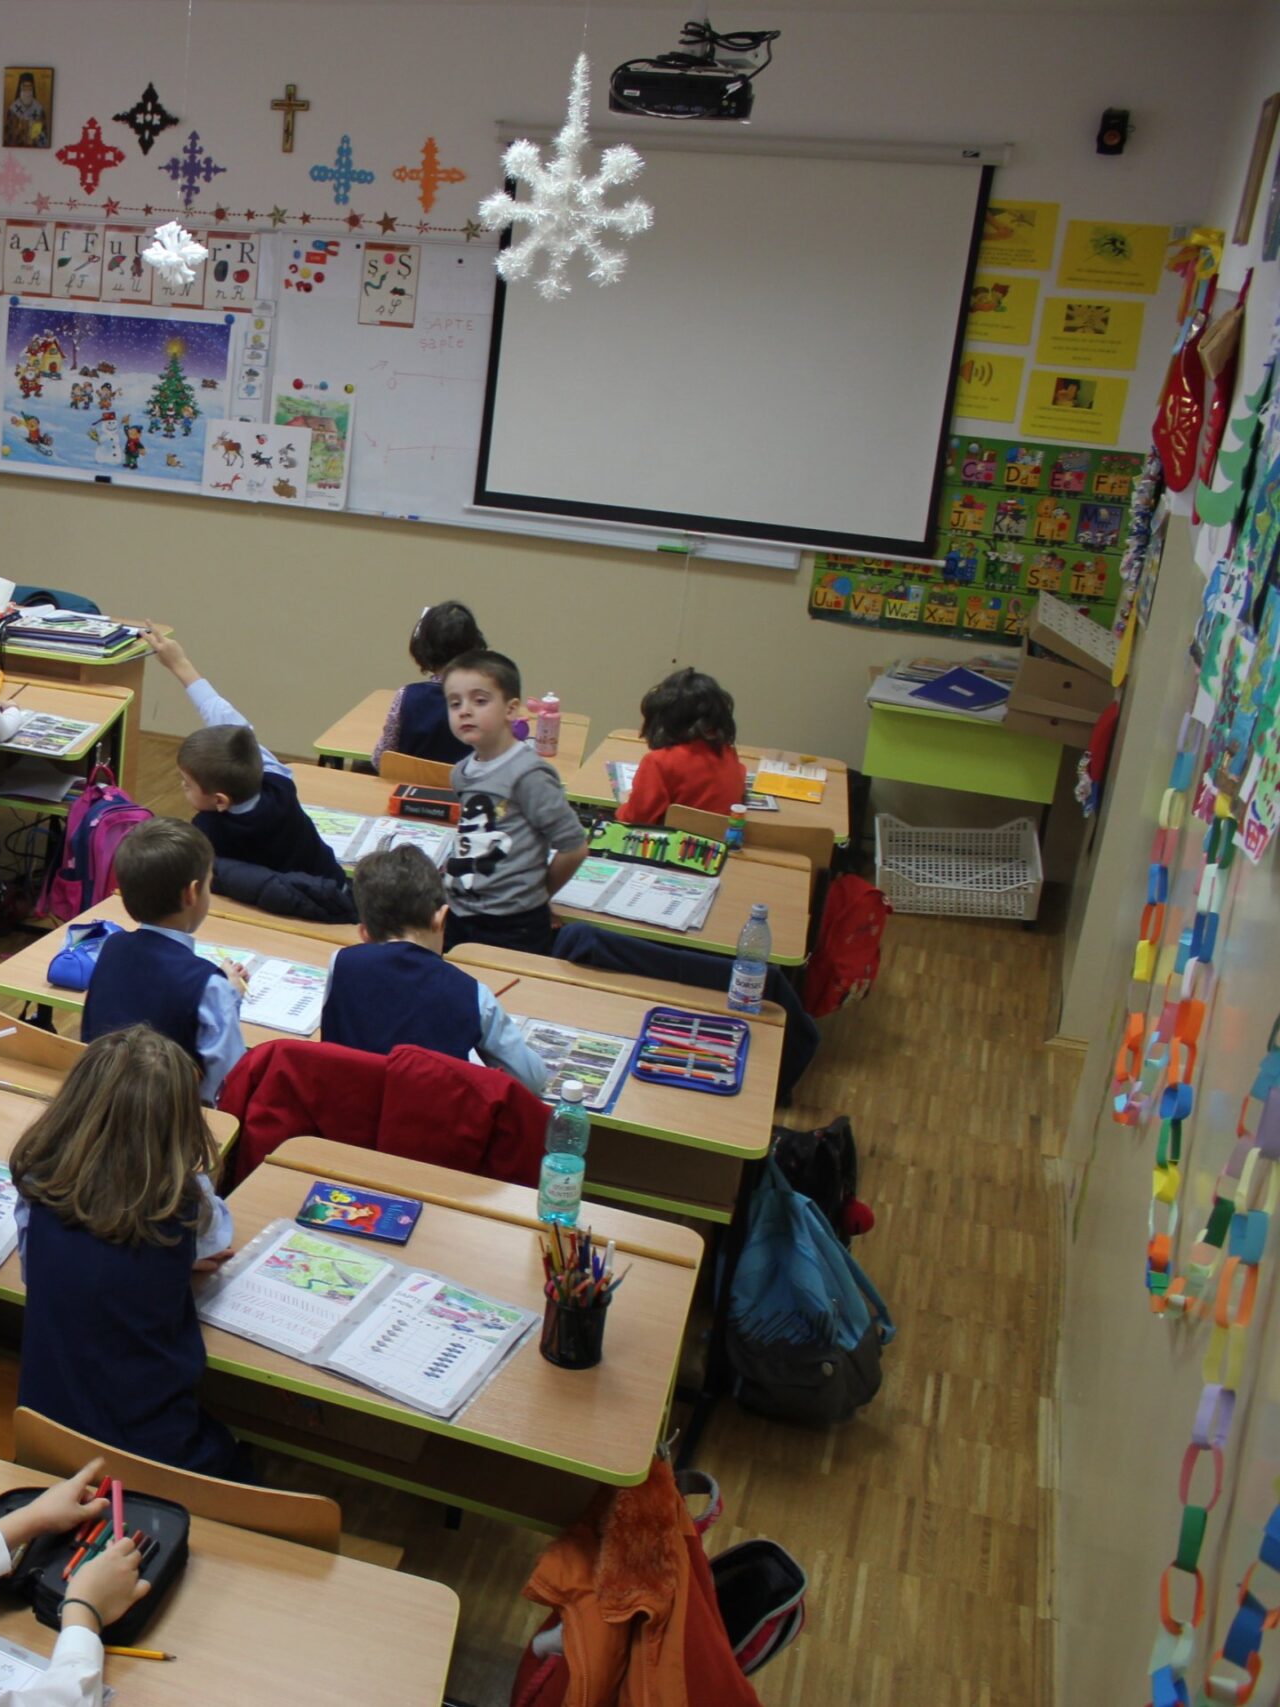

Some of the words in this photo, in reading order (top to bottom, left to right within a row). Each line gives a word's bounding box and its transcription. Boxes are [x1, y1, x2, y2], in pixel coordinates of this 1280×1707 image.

[61, 231, 70, 250] f
[83, 232, 99, 254] F
[110, 240, 122, 255] u
[211, 247, 222, 262] r
[239, 241, 256, 264] R
[459, 836, 471, 857] S
